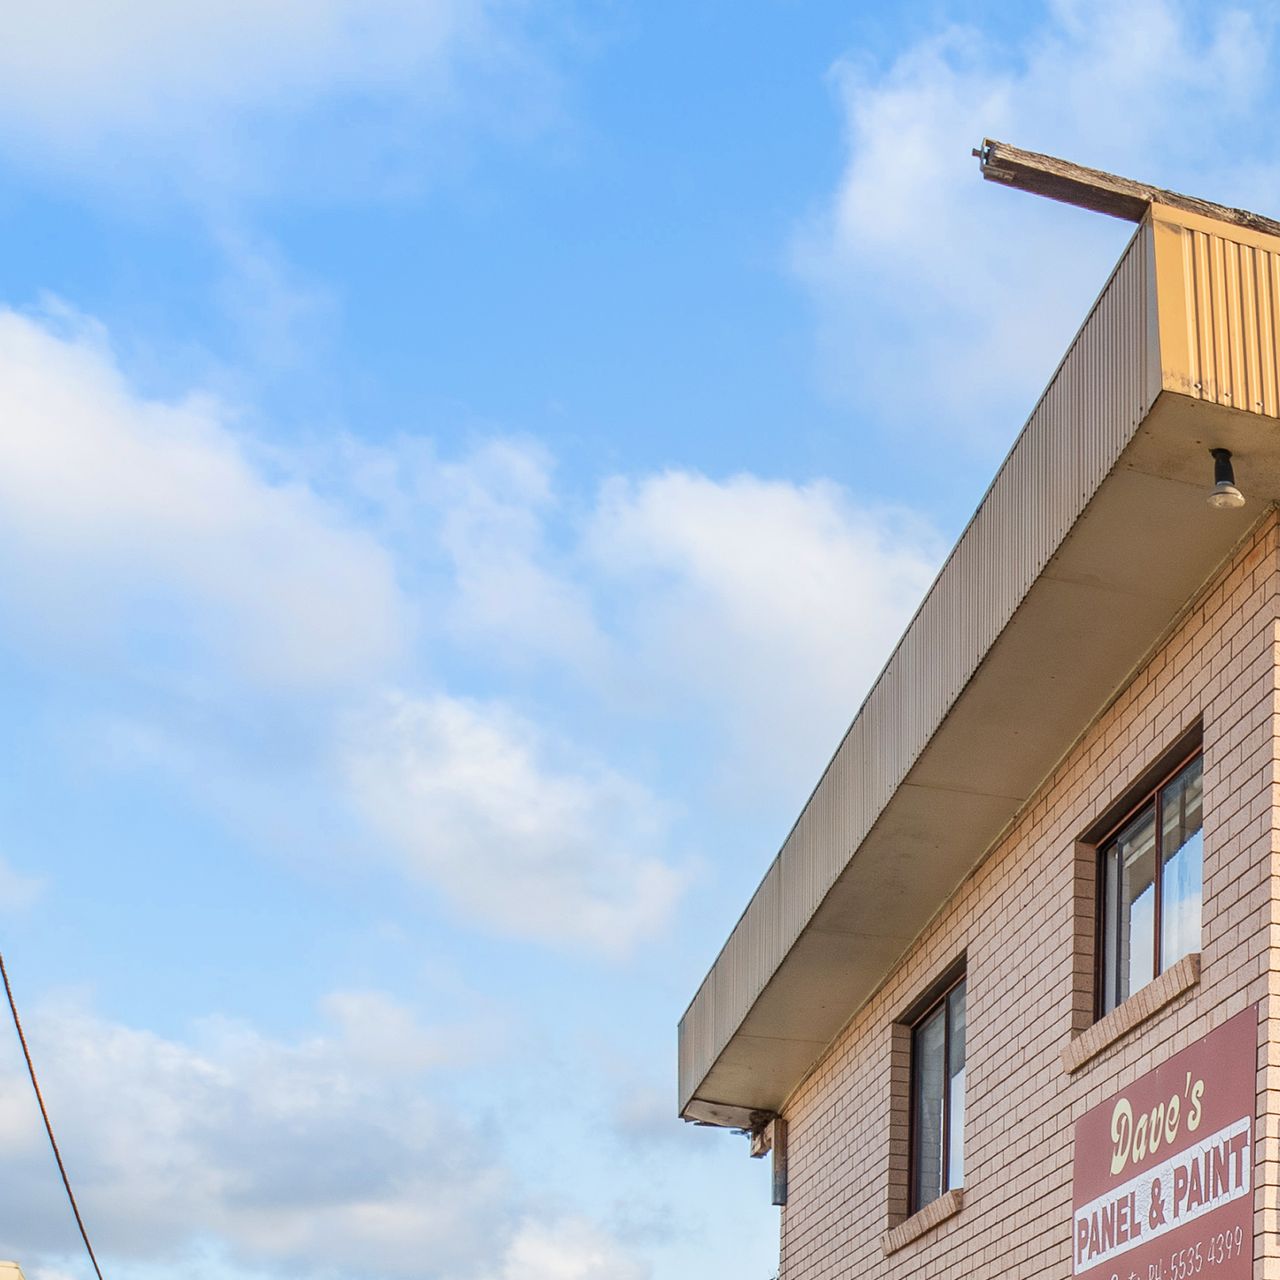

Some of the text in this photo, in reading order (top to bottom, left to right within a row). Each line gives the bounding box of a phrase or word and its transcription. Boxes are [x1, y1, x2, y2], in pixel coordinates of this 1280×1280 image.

[1110, 1072, 1204, 1176] Dave's
[1077, 1188, 1140, 1265] PANEL
[1148, 1177, 1165, 1230] &
[1173, 1128, 1249, 1219] PAINT
[1207, 1226, 1243, 1266] 4399
